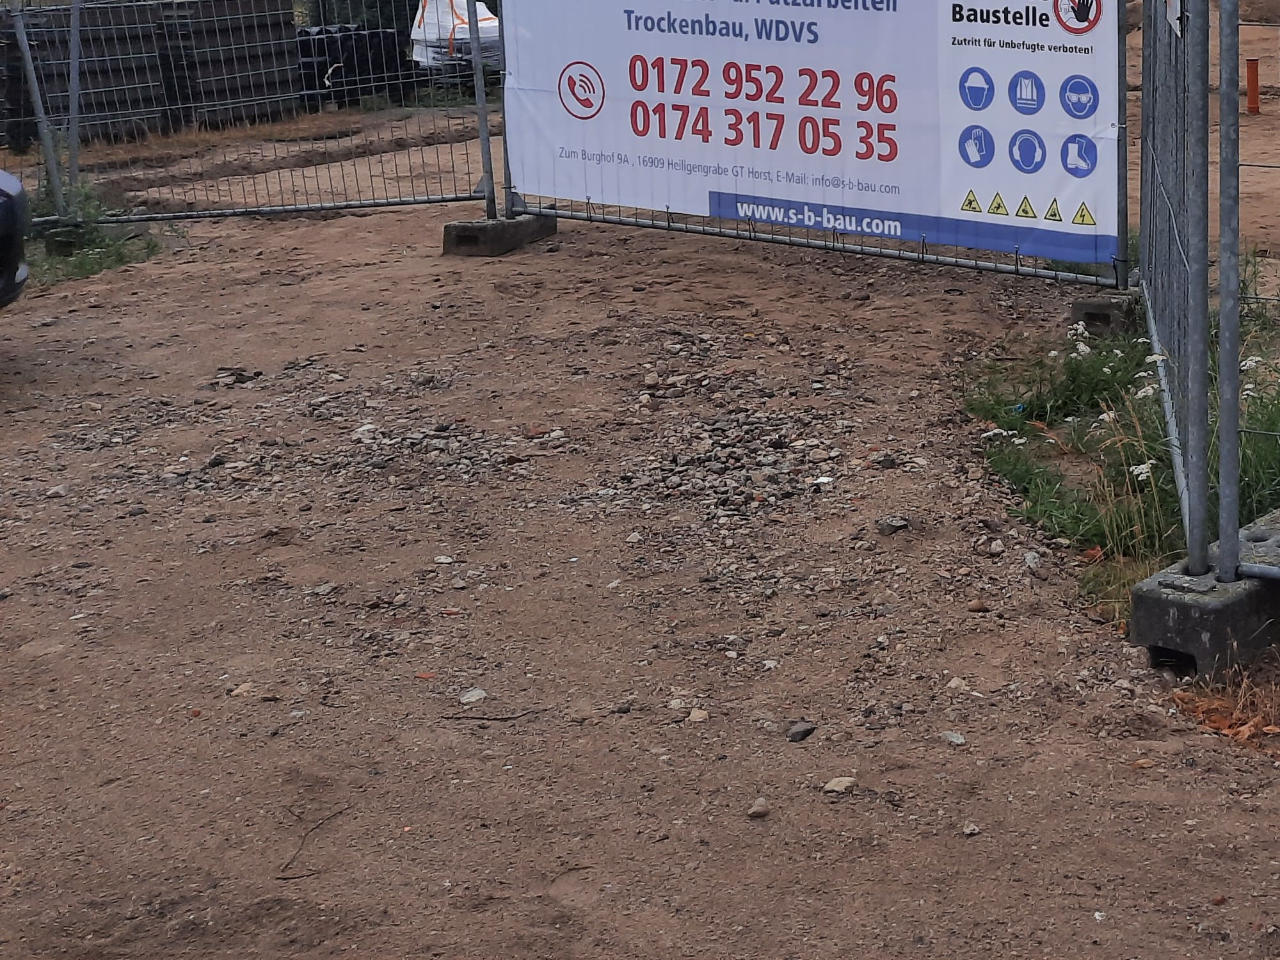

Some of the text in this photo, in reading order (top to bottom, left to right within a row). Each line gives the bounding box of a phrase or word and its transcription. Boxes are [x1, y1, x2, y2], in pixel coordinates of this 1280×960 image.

[624, 9, 819, 44] Trockenbau, WDVS
[951, 3, 1050, 28] Baustelle
[951, 36, 1093, 55] Zutritt für Unbefugte verboten!
[628, 53, 898, 114] 0172 952 22 96
[629, 100, 899, 163] 0174 317 05 35
[558, 146, 579, 159] Zum
[581, 151, 615, 166] Burghof
[637, 155, 665, 169] 16909
[667, 159, 729, 177] Heiligengrabe
[731, 165, 745, 178] GT
[747, 167, 773, 184] Horst,
[776, 170, 809, 185] E-Mail:
[736, 201, 902, 236] www.s-b-bau.com
